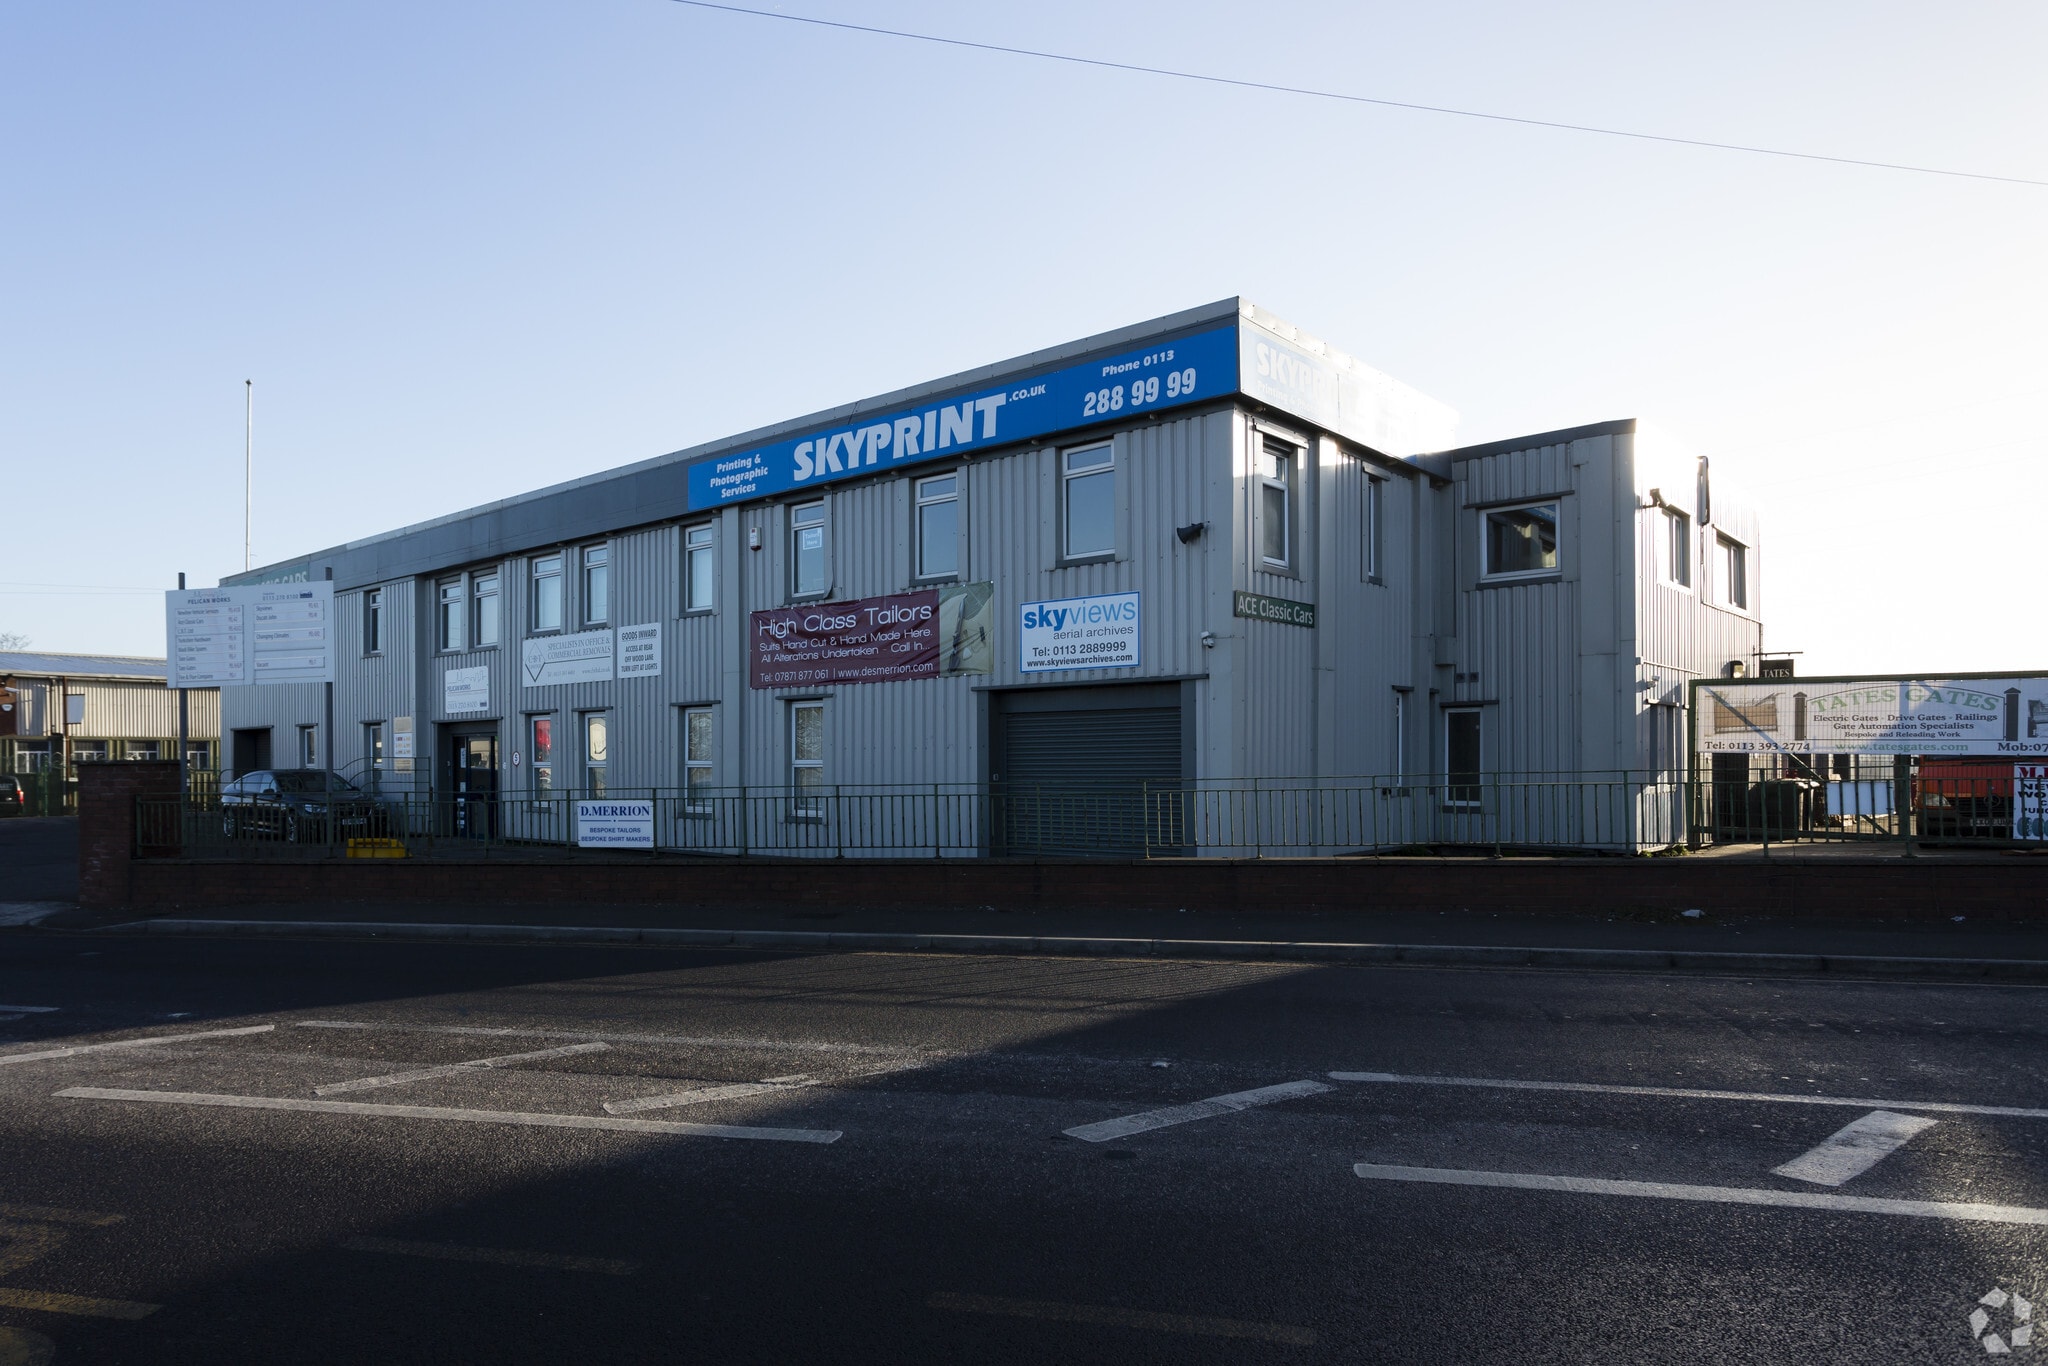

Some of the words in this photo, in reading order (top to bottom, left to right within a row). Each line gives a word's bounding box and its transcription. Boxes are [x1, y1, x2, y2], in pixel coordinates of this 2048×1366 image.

[1102, 360, 1140, 377] Phone
[1143, 350, 1174, 366] 0113
[1083, 385, 1124, 416] 288
[1131, 376, 1159, 406] 99
[1166, 368, 1196, 398] 99
[794, 392, 1006, 482] SKYPRINT
[1009, 384, 1046, 402] .CO.UK
[716, 458, 752, 473] Printing
[754, 454, 761, 464] &
[710, 467, 768, 488] Photographic
[721, 483, 756, 498] Services
[1024, 601, 1136, 631] skyviews
[1238, 595, 1257, 615] ACE
[1260, 600, 1292, 620] Classic
[1294, 606, 1313, 624] Cars
[759, 618, 796, 638] High
[804, 614, 856, 632] Class
[864, 605, 932, 625] Tailors
[622, 631, 637, 640] GOODS
[639, 629, 657, 640] INWARD
[759, 642, 780, 652] Suits
[783, 639, 807, 649] Hand
[811, 638, 826, 647] Cut
[830, 637, 837, 646] &
[840, 634, 867, 644] Hand
[870, 630, 900, 642] Made
[904, 628, 932, 638] Here.
[1053, 628, 1082, 640] aerial
[1086, 626, 1134, 638] archives
[548, 640, 578, 651] SPECIALISTS
[585, 638, 604, 647] OFFICE
[548, 649, 581, 660] COMMERCIAL
[583, 646, 611, 656] REMOVALS
[761, 654, 771, 663] All
[773, 650, 818, 662] Alterations
[822, 646, 878, 659] Undertaken
[891, 642, 910, 653] Call
[1032, 647, 1050, 657] Tel:
[1053, 644, 1076, 655] 0113
[1080, 641, 1126, 654] 2889999
[1027, 654, 1133, 667] www.skyviewsarchives.com
[760, 673, 773, 682] Tel:
[774, 671, 797, 682] 07871
[799, 670, 814, 680] 877
[814, 670, 828, 679] 061
[838, 662, 933, 678] www.desmerrion.com
[1762, 669, 1790, 678] TATES
[1811, 688, 1896, 712] TATES
[1905, 689, 1999, 711] GATES
[1920, 722, 1974, 731] Specialists
[1955, 714, 1998, 722] Railings
[1705, 741, 1725, 749] Tel:
[1759, 742, 1778, 750] 393
[1782, 742, 1810, 751] 2774
[1836, 742, 1969, 752] www.tatesgates.com
[581, 806, 650, 816] D.MERRION
